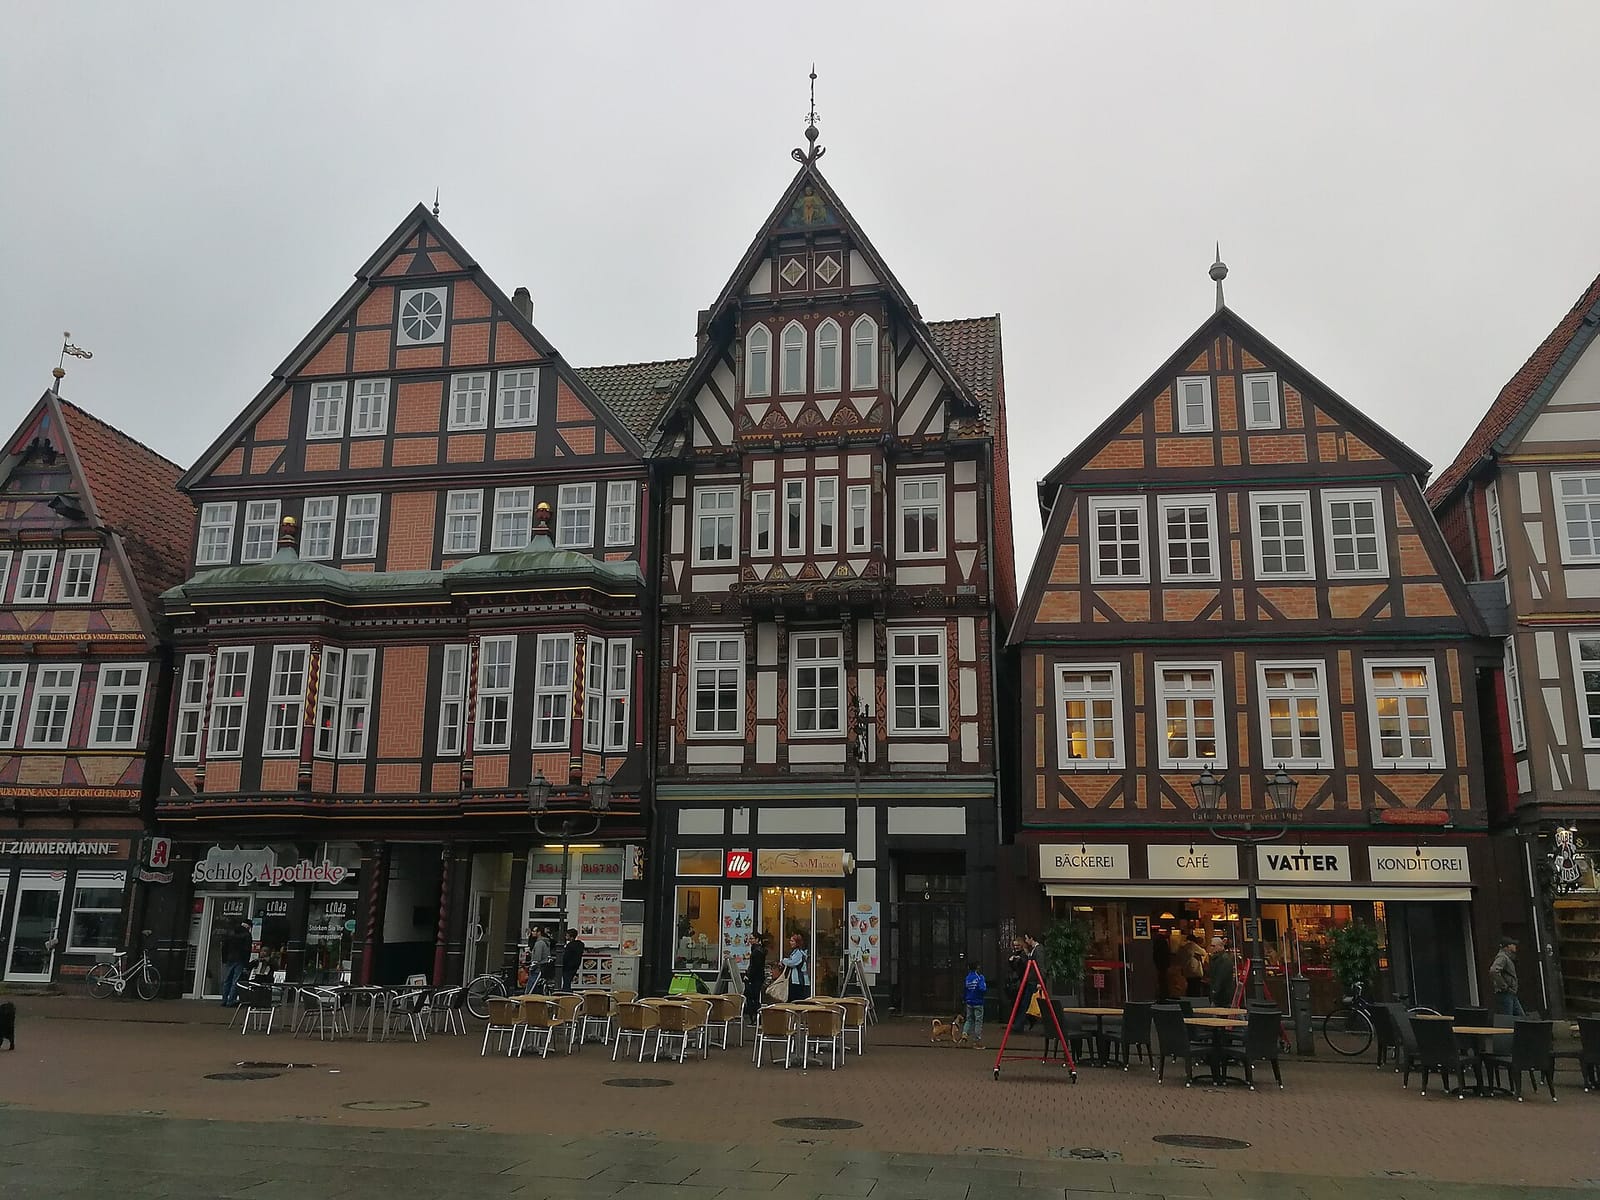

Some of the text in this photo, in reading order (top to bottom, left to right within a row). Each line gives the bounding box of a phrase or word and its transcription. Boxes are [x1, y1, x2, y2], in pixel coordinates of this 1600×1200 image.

[10, 841, 109, 855] ZIMMERMANN
[582, 863, 619, 873] BISTRO
[728, 855, 751, 876] illy
[1055, 853, 1114, 869] BÄCKEREI
[1176, 853, 1210, 869] CAFÉ
[1267, 854, 1339, 871] VATTER
[1376, 857, 1463, 872] KONDITOREI
[195, 862, 254, 886] Schloß
[259, 861, 344, 886] Apotheke
